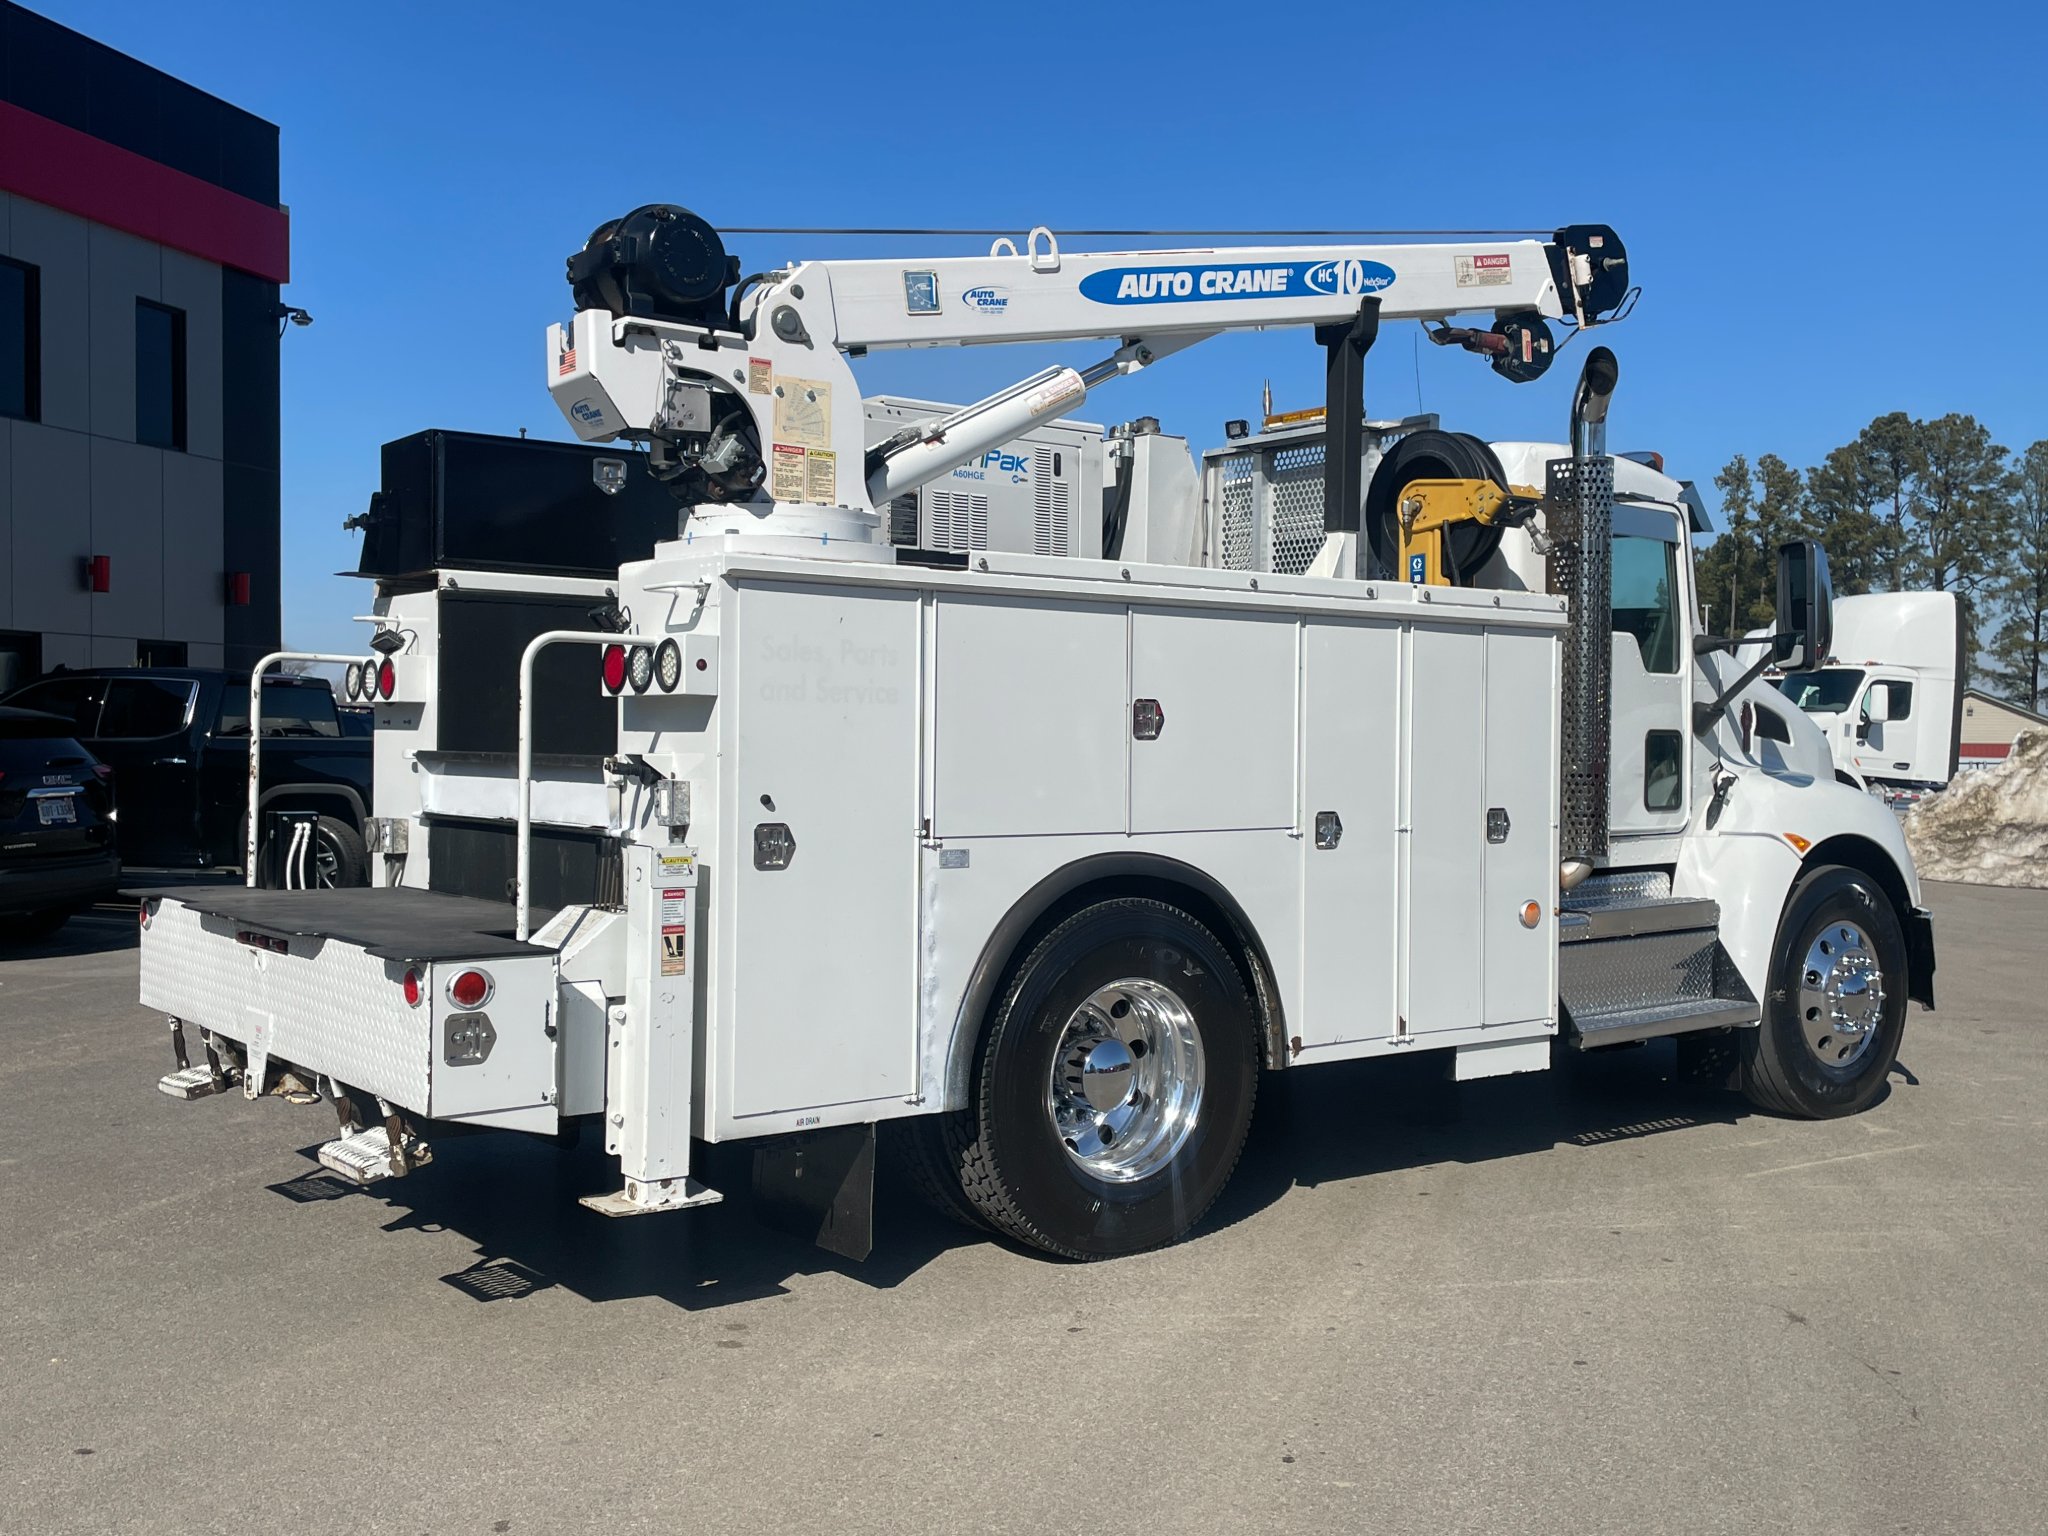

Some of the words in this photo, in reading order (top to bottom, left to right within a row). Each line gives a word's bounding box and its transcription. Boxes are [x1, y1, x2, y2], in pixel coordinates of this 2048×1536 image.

[1482, 257, 1508, 266] DANGER
[1317, 268, 1333, 283] HC
[1333, 259, 1363, 295] 10
[1117, 272, 1193, 299] AUTO
[1199, 268, 1288, 295] CRANE
[970, 290, 994, 298] AUTO
[977, 298, 1008, 306] CRANE
[574, 404, 590, 414] AUTO
[582, 409, 602, 420] CRANE
[953, 469, 985, 480] A60HGE
[840, 638, 898, 667] Parts
[760, 672, 806, 702] and
[816, 676, 898, 704] Service
[796, 1118, 804, 1127] AIR
[805, 1116, 821, 1125] DRAIN
